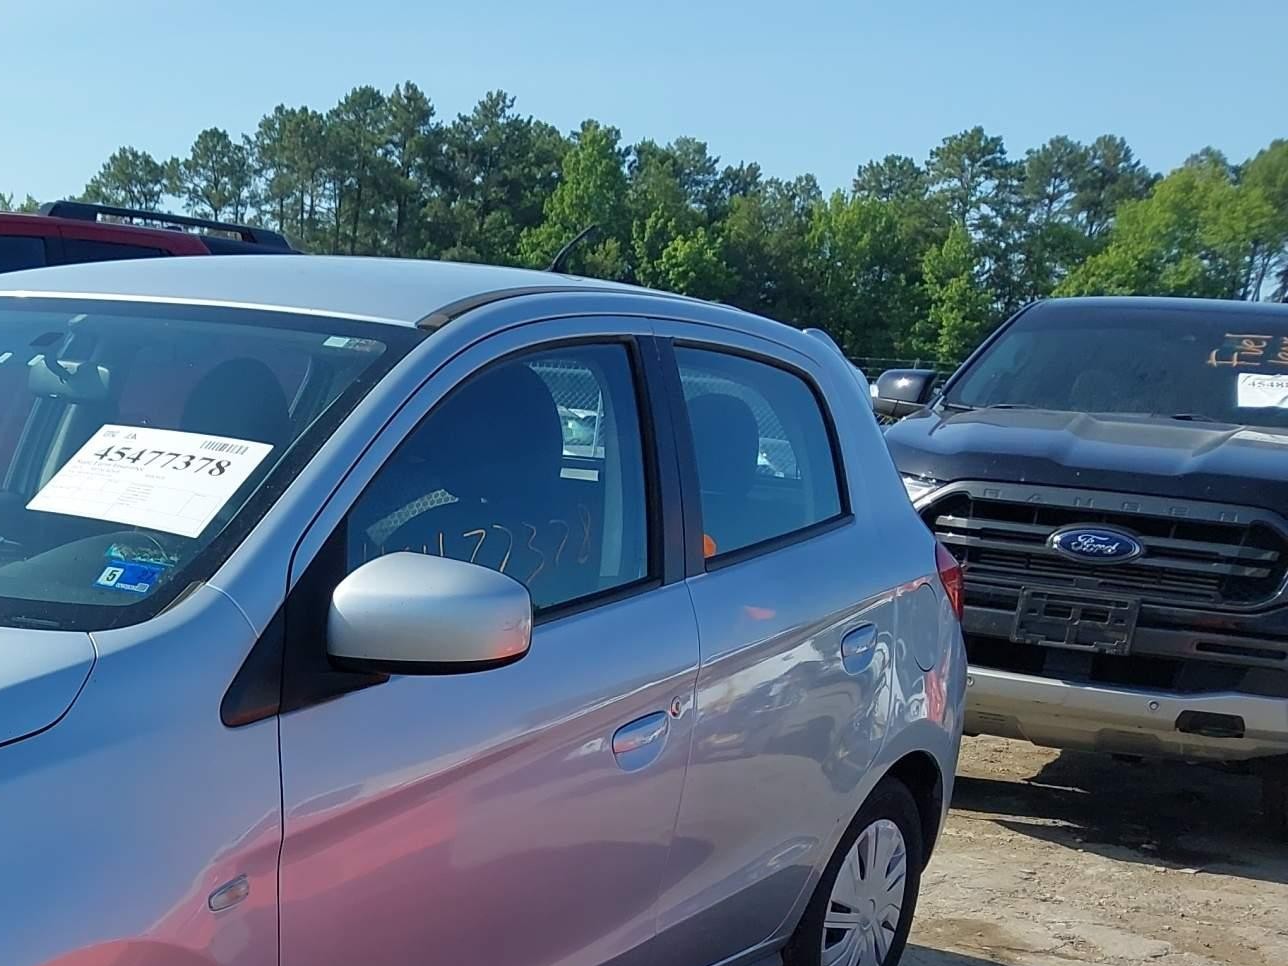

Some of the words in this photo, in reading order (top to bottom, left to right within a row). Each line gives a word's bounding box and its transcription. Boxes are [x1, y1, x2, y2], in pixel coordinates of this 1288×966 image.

[93, 444, 232, 477] 45477378
[1070, 533, 1119, 555] Ford
[105, 569, 120, 582] 5
